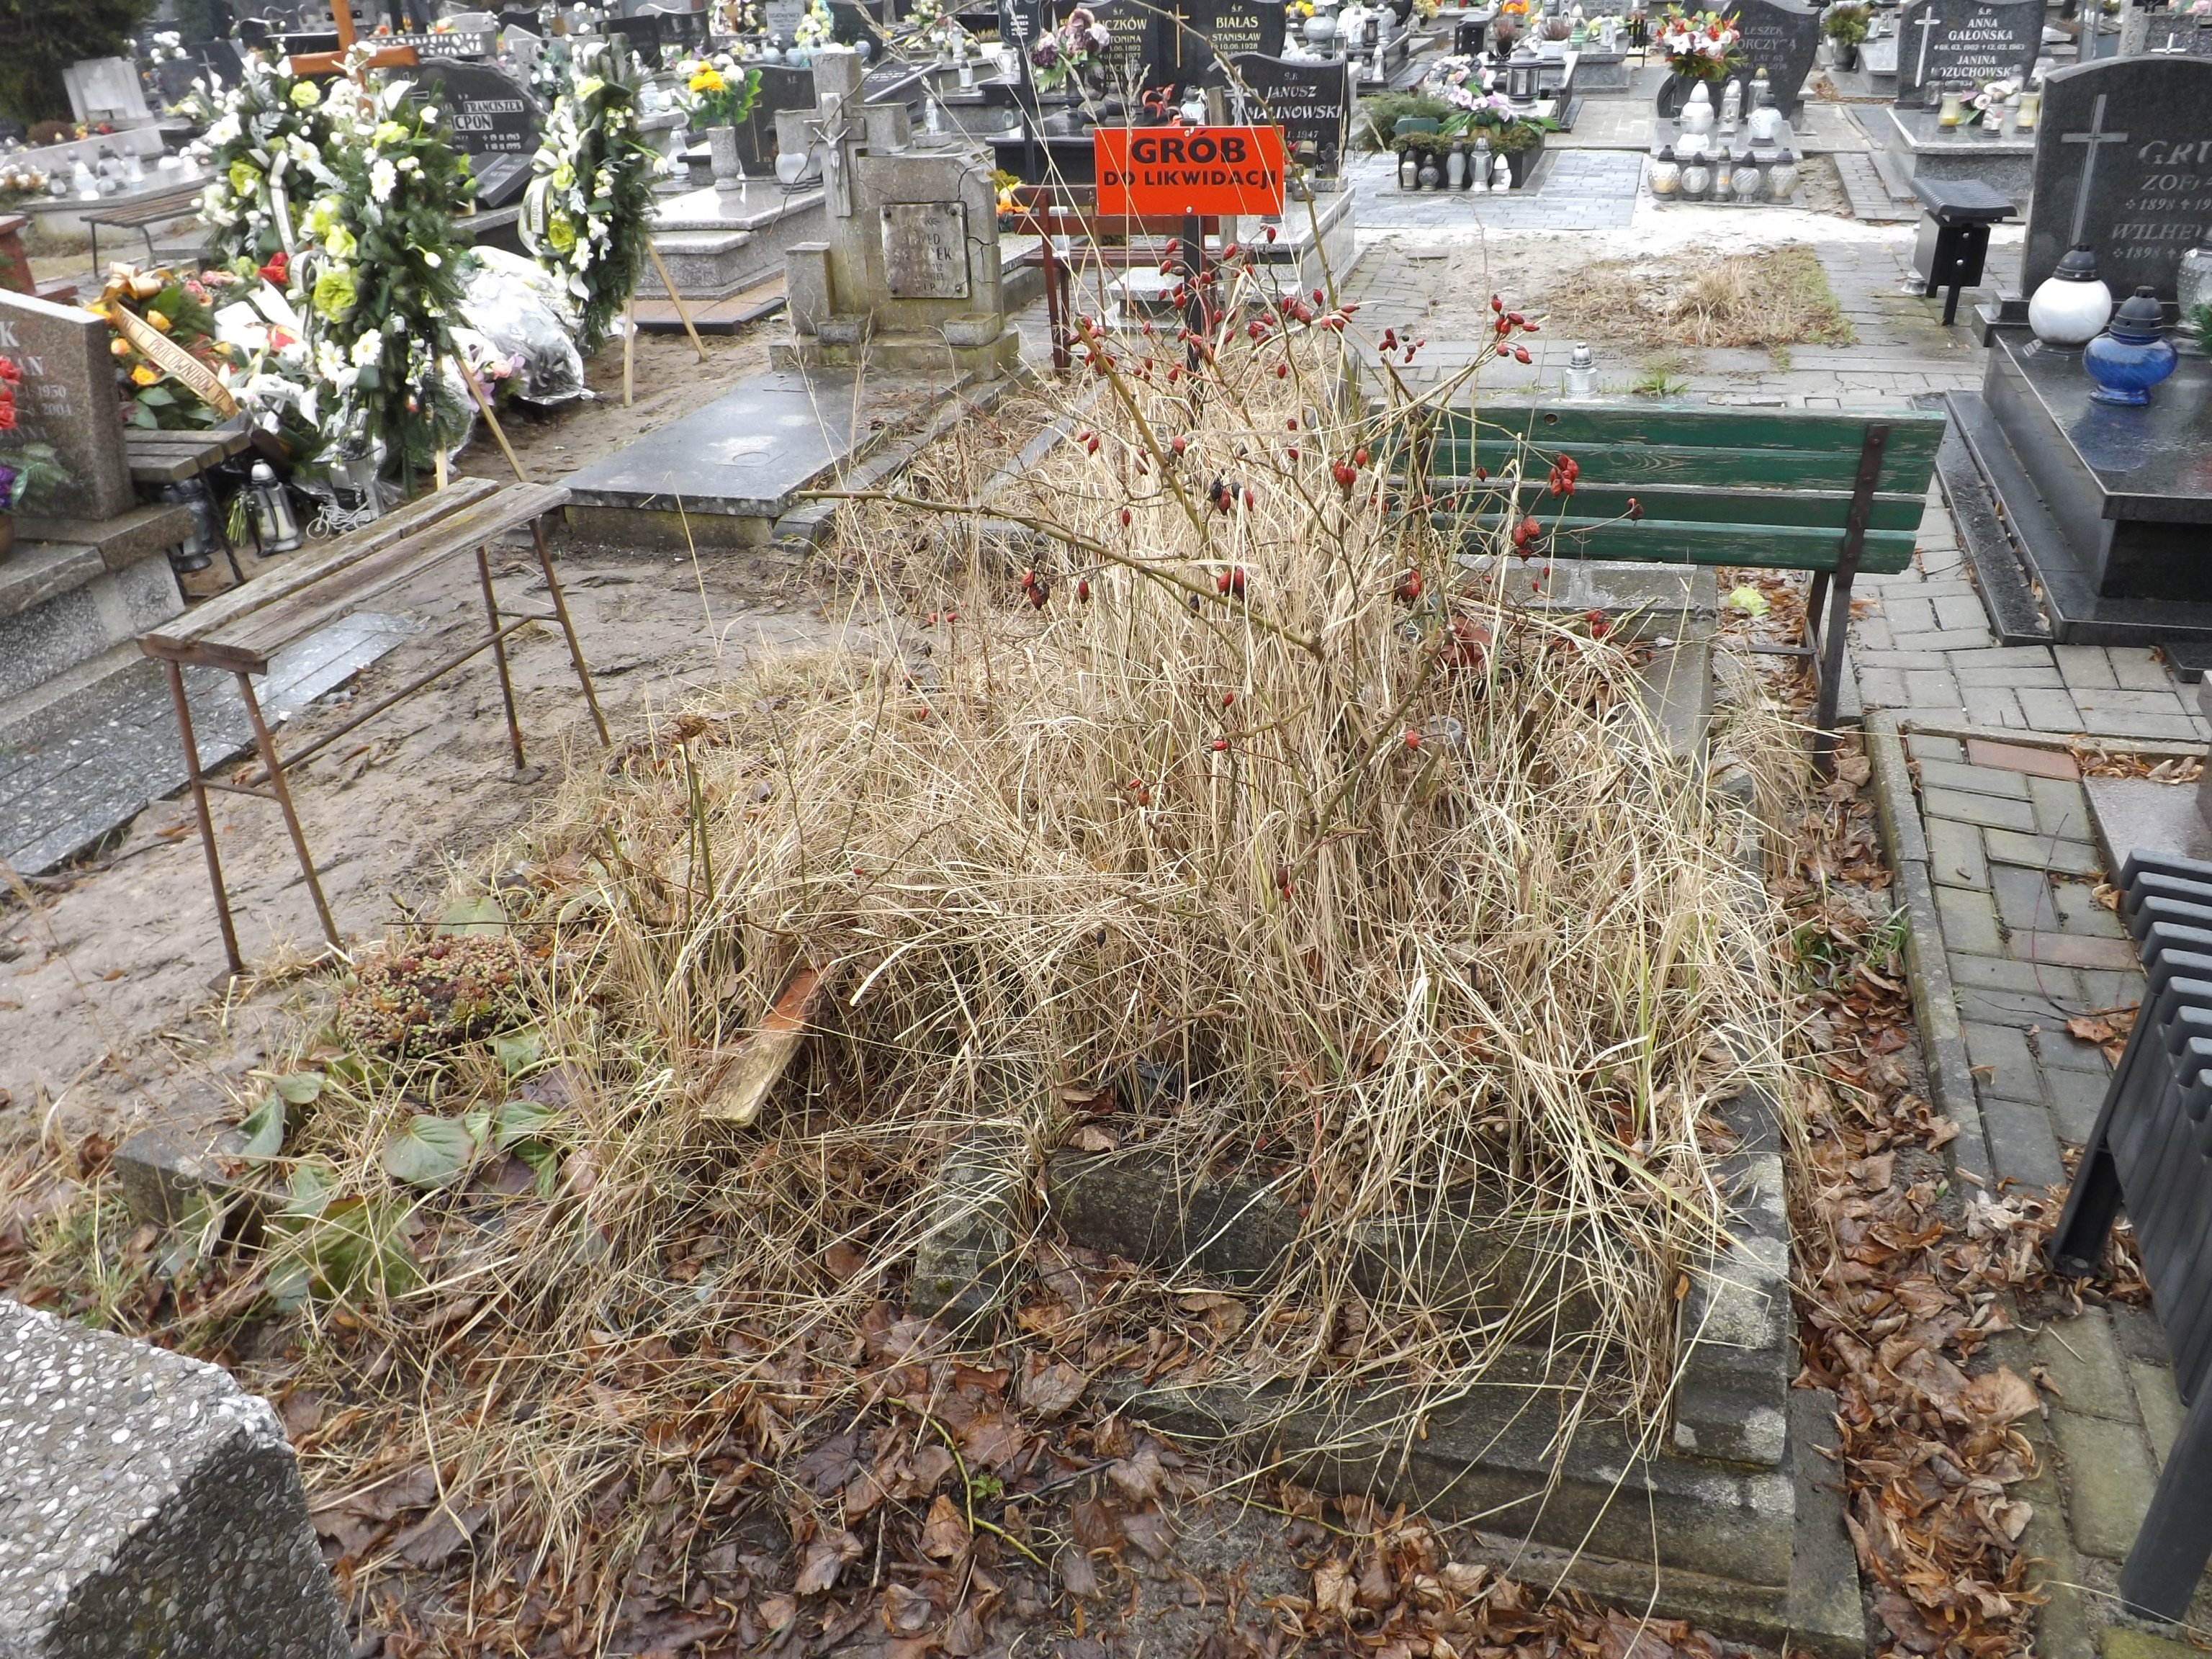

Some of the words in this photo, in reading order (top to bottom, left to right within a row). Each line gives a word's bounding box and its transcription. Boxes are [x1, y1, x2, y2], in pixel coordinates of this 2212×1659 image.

[1967, 18, 1998, 28] ANNA
[1744, 26, 1784, 35] LESZEK
[1956, 55, 1997, 65] JANINA
[1265, 86, 1318, 99] JANUSZ
[464, 100, 523, 112] FRANCISZEK
[1131, 130, 1246, 164] GRÓB
[1103, 170, 1136, 186] DO
[1143, 170, 1277, 190] LIKWIDACJI
[2139, 198, 2176, 211] 1898
[2125, 246, 2161, 259] 1898
